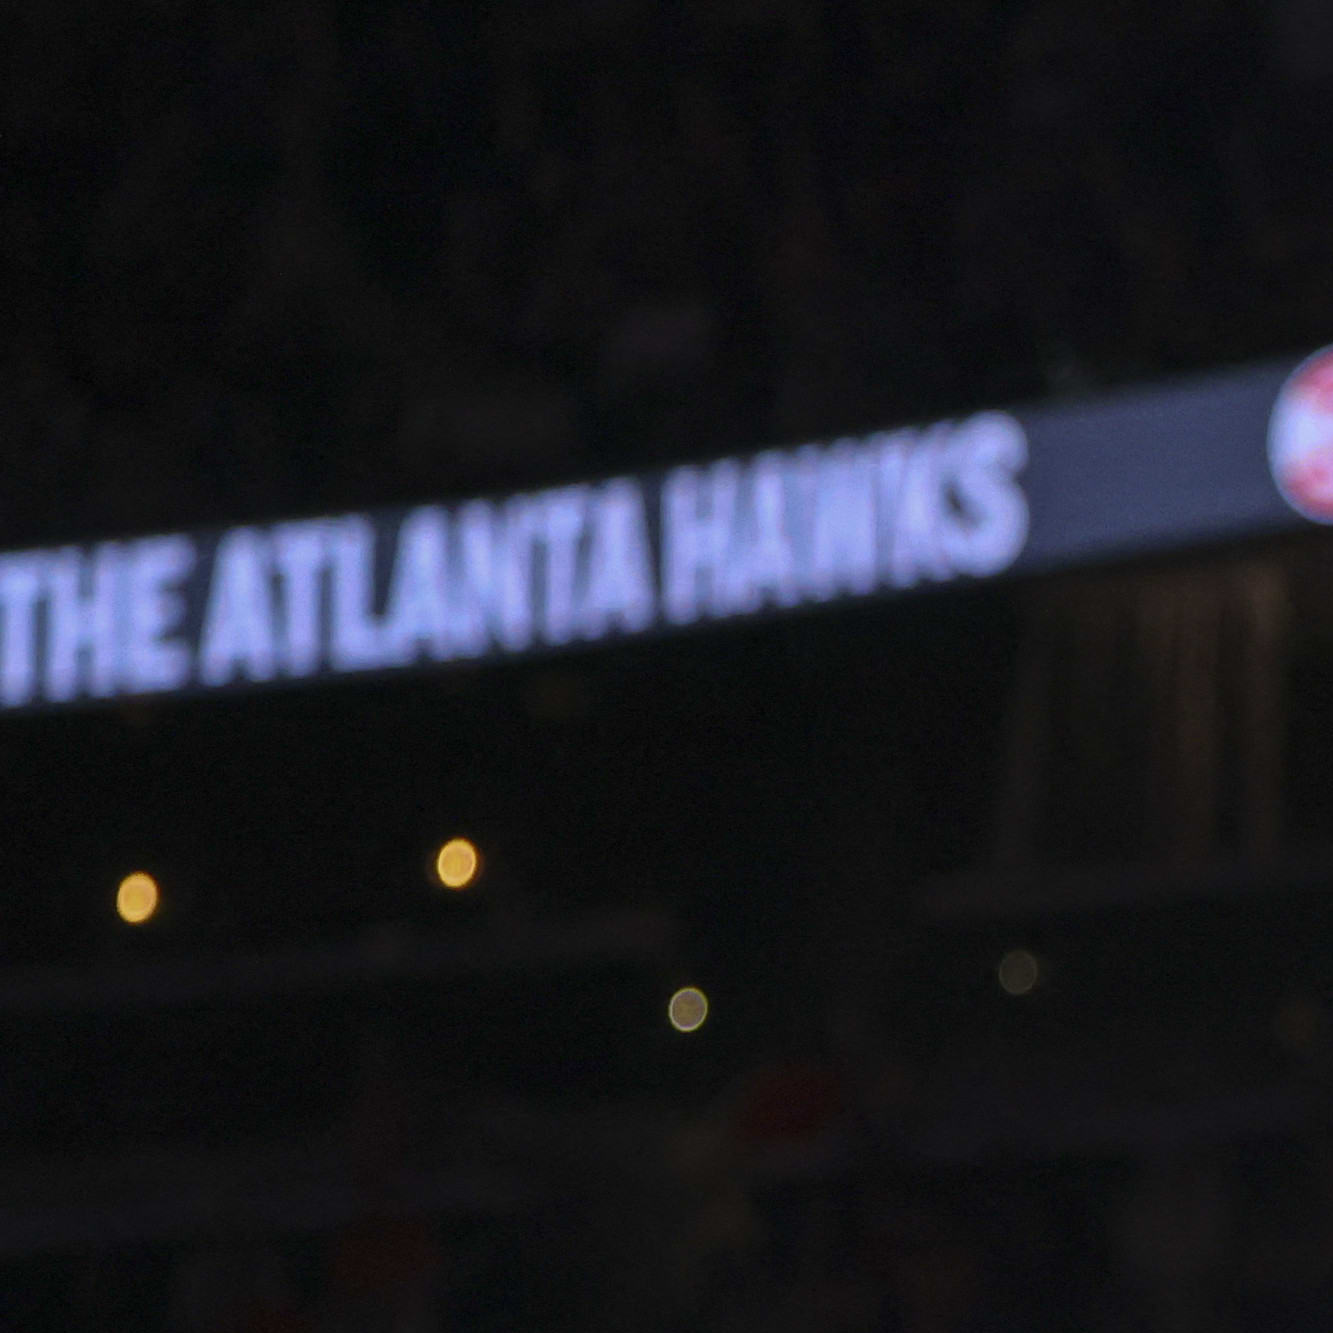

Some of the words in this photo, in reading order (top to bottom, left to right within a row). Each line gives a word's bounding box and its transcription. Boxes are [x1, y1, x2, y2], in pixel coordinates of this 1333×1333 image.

[0, 534, 192, 708] THE
[202, 474, 650, 688] ATLANTA
[660, 409, 1028, 626] HAWKS
